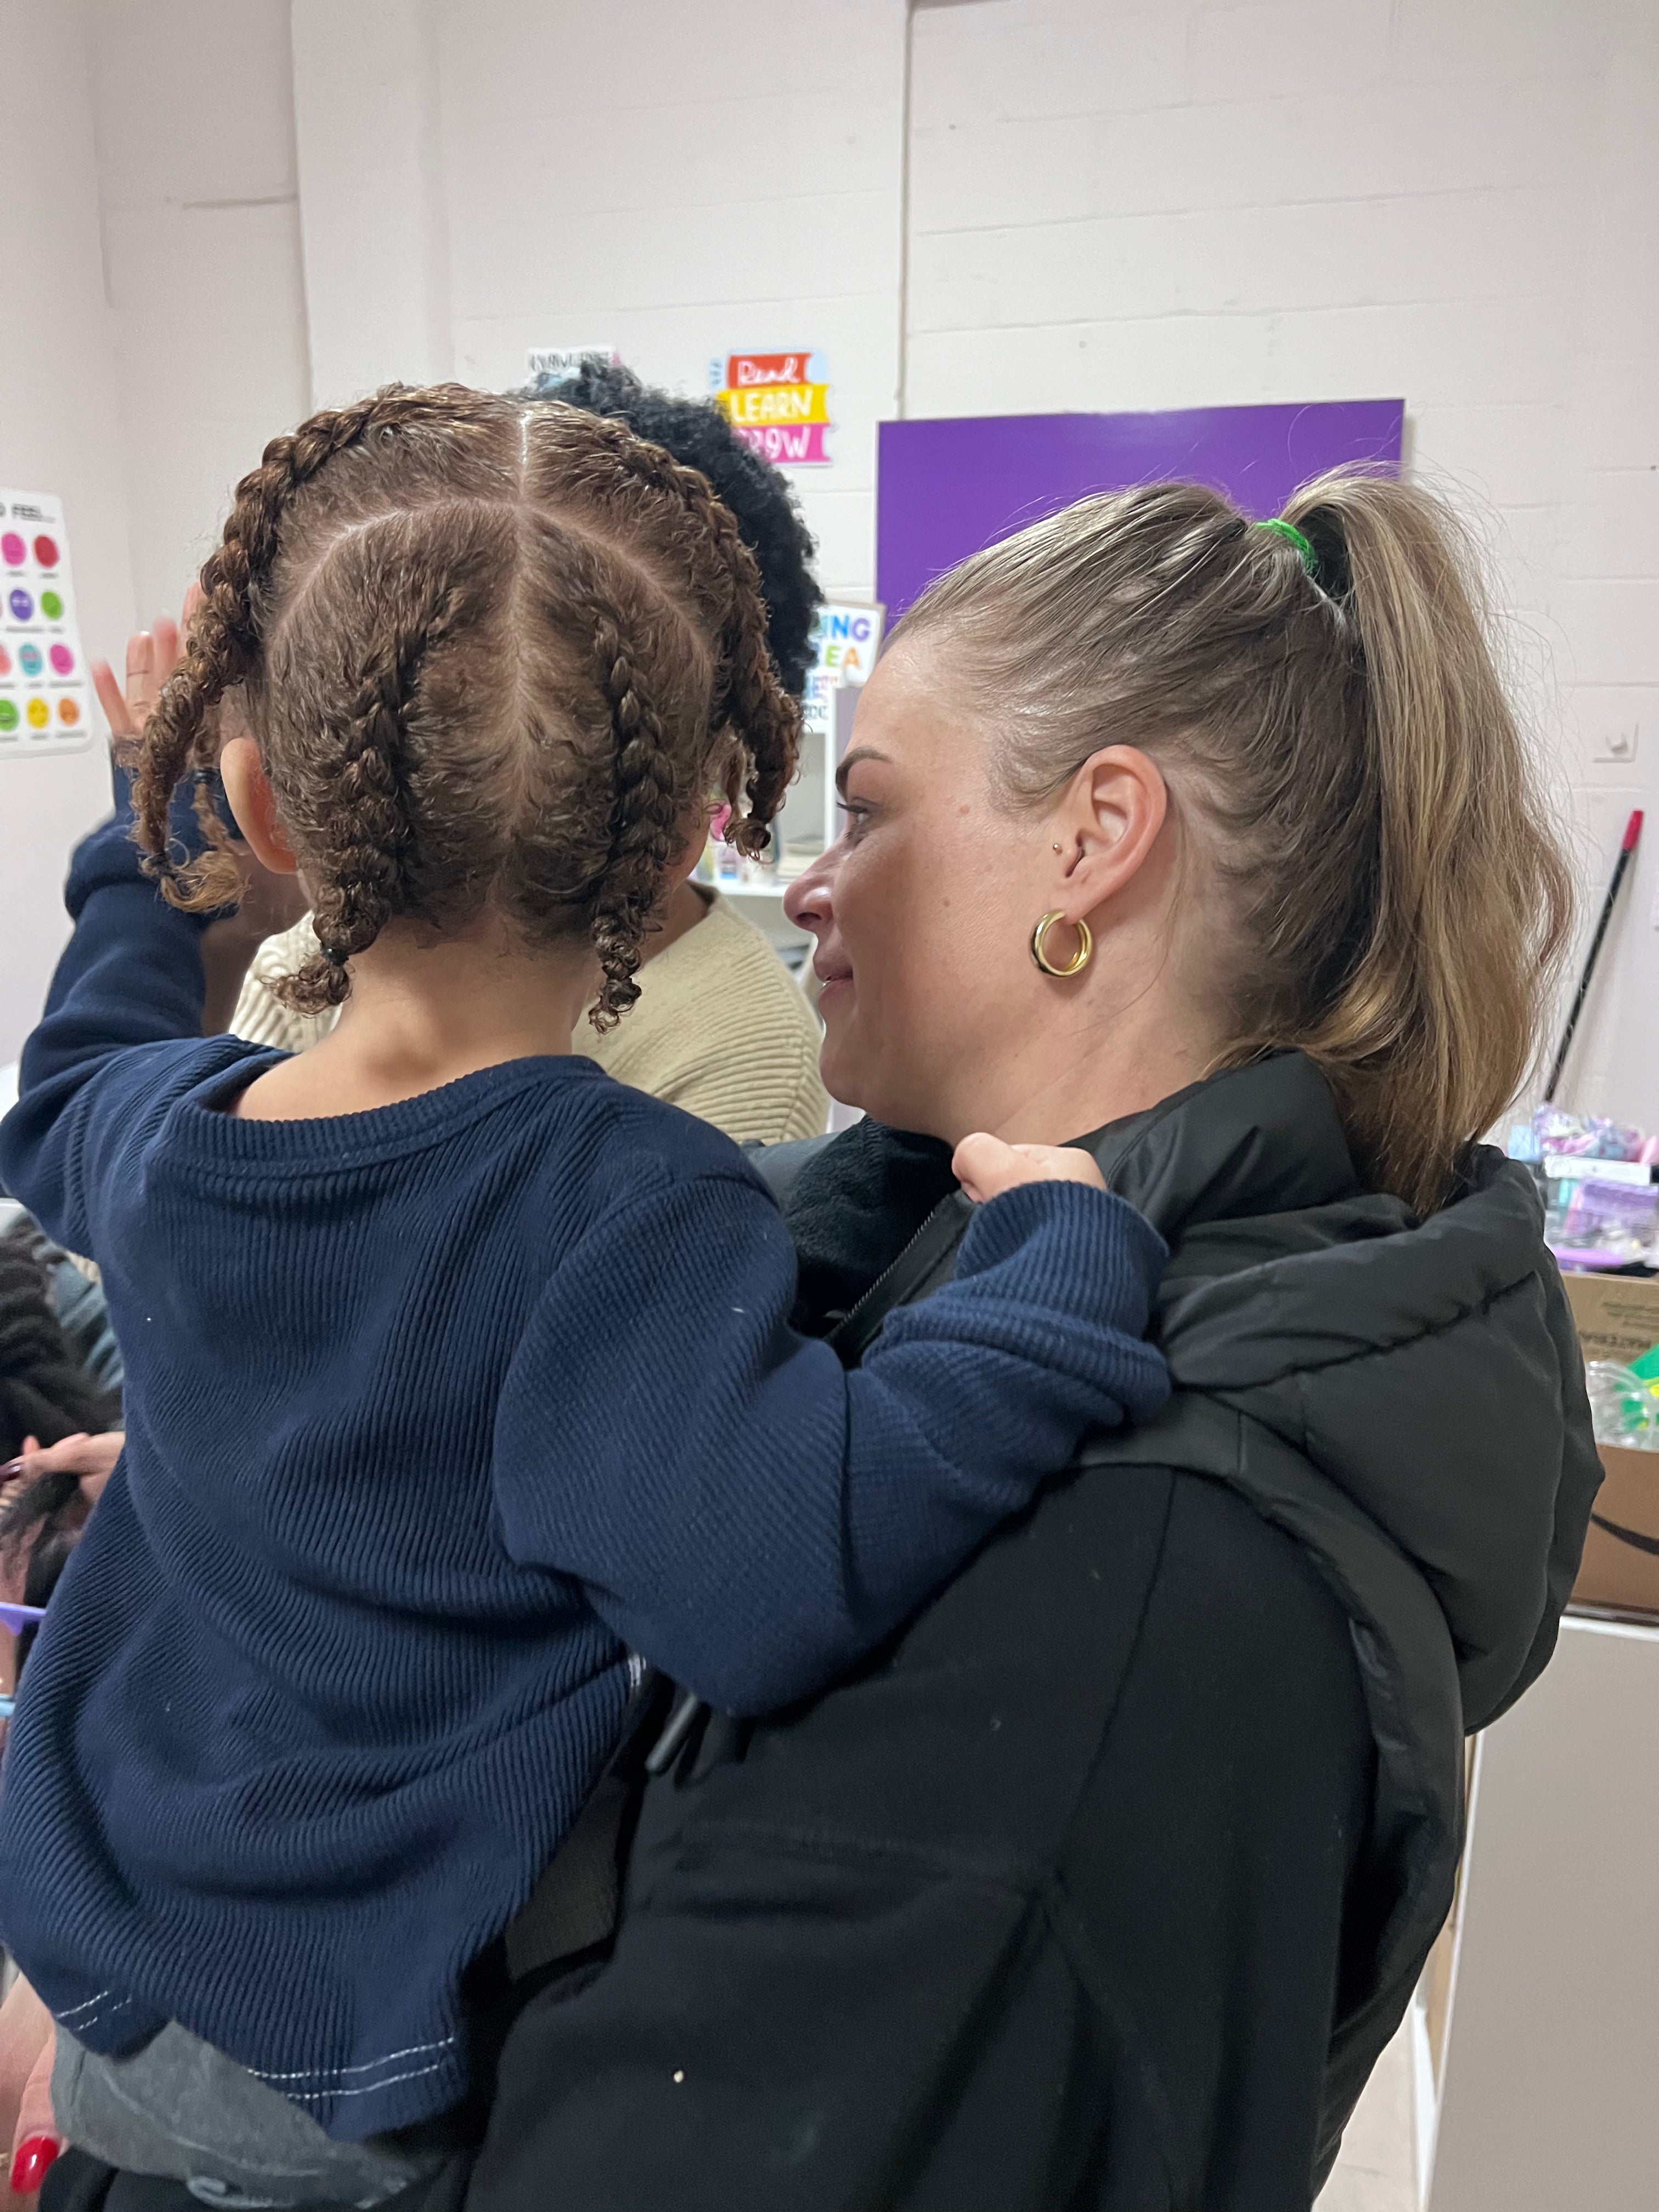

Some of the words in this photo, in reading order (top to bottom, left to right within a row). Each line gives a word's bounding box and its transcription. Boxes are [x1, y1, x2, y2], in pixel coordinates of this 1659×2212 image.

[738, 358, 799, 385] Read
[730, 388, 813, 422] LEARN
[736, 425, 811, 459] ROW
